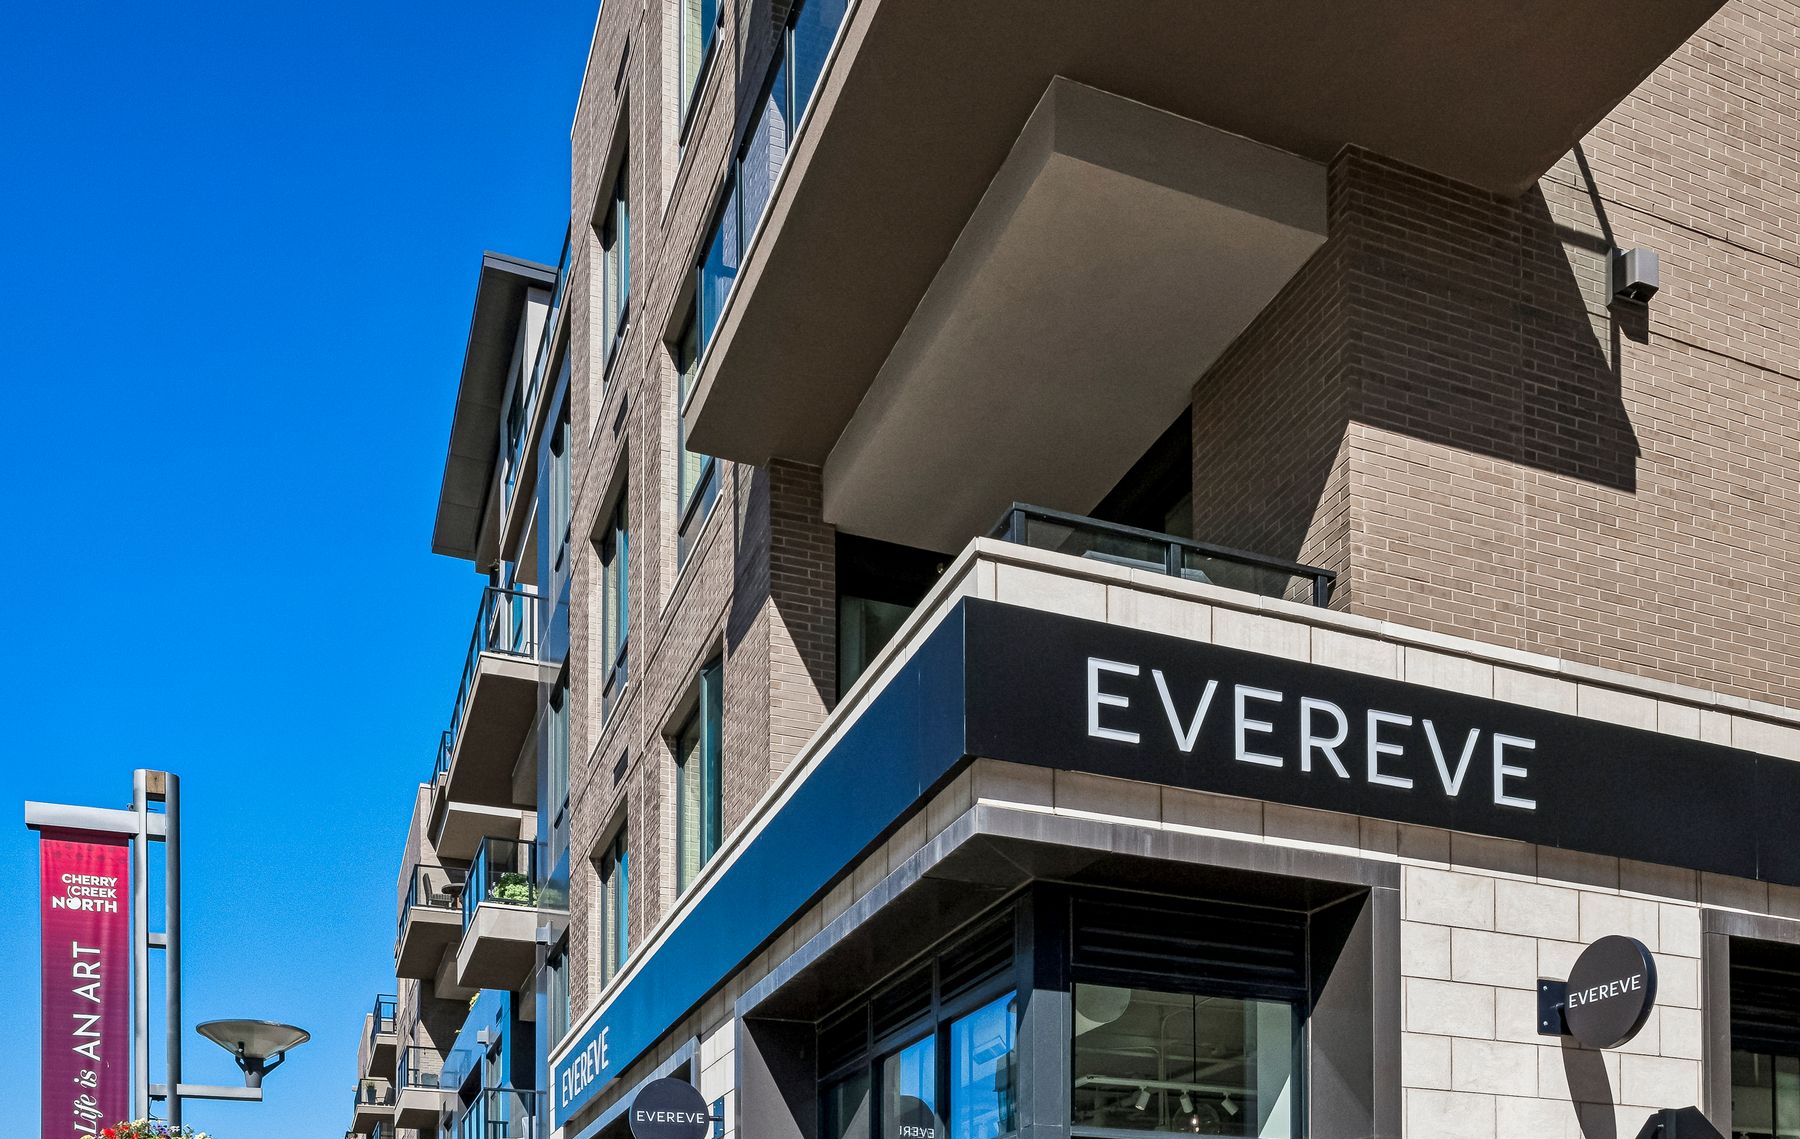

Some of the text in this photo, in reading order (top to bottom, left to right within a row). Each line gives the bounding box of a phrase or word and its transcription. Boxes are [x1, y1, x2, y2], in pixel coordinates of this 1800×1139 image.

[1087, 656, 1537, 810] EVEREVE
[61, 873, 118, 887] CHERRY
[70, 885, 117, 899] CREEK
[52, 896, 118, 913] NORTH
[1568, 974, 1641, 1009] EVEREVE
[72, 941, 103, 1135] Life is AN ART
[562, 1026, 609, 1108] EVEREVE
[636, 1110, 705, 1124] EVEREVE
